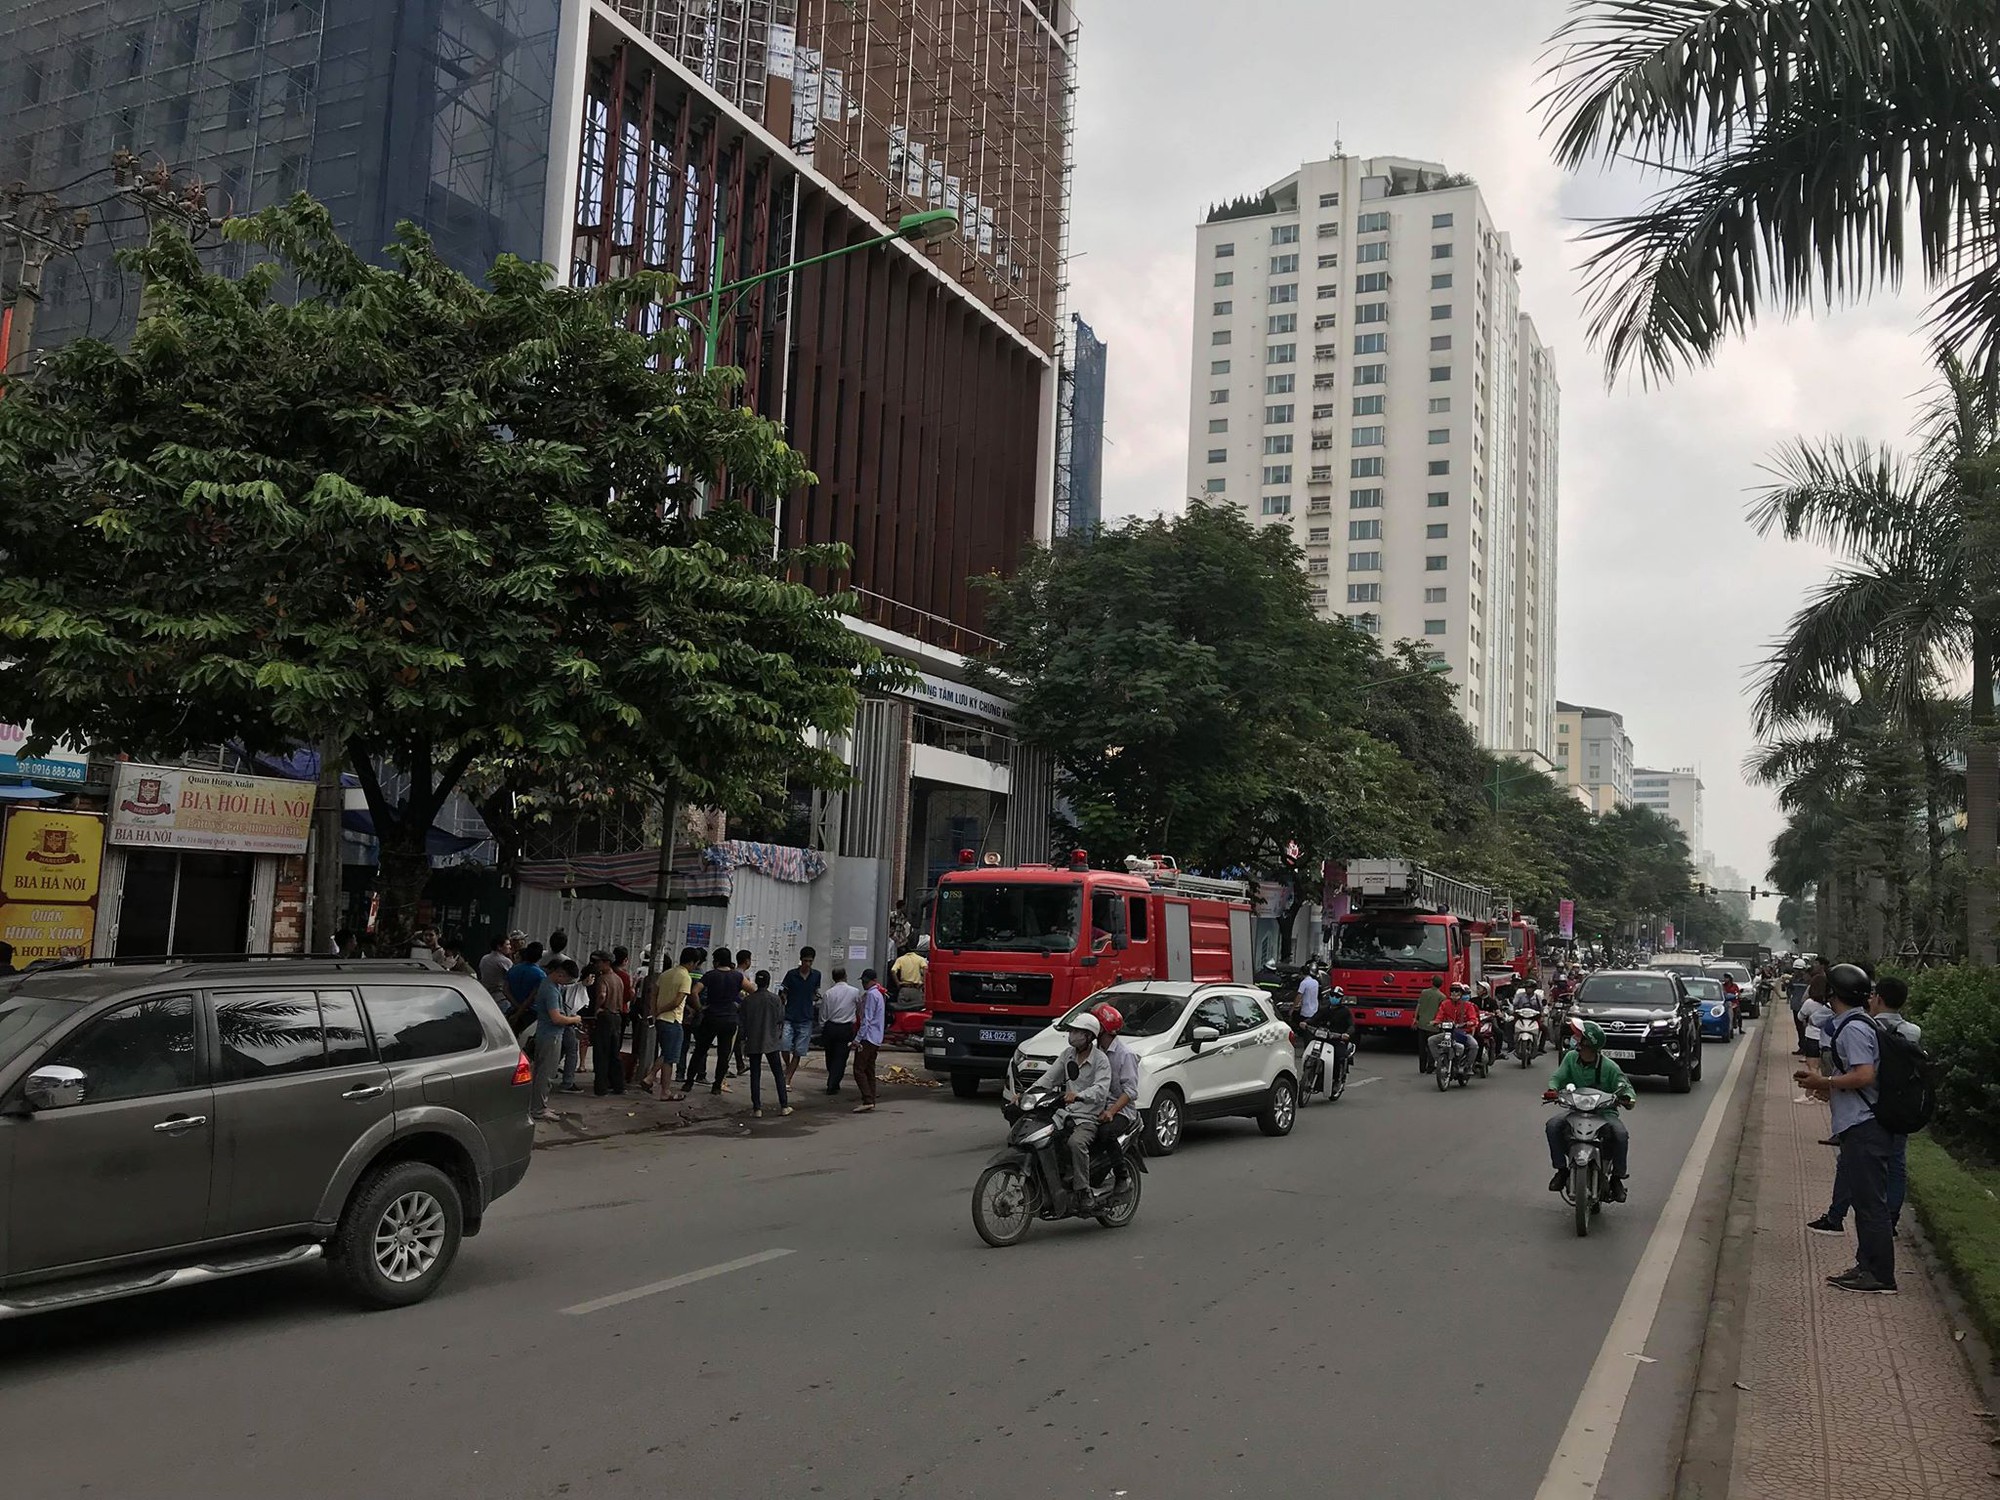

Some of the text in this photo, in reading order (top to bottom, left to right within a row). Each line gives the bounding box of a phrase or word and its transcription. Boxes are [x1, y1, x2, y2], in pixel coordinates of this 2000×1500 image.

[31, 763, 50, 775] 0916
[52, 765, 66, 777] 888
[67, 767, 81, 779] 268
[180, 790, 310, 822] BIA HƠI HÀ NỘI
[115, 828, 133, 841] BIA
[14, 875, 37, 889] BIA
[982, 983, 1017, 992] MAN
